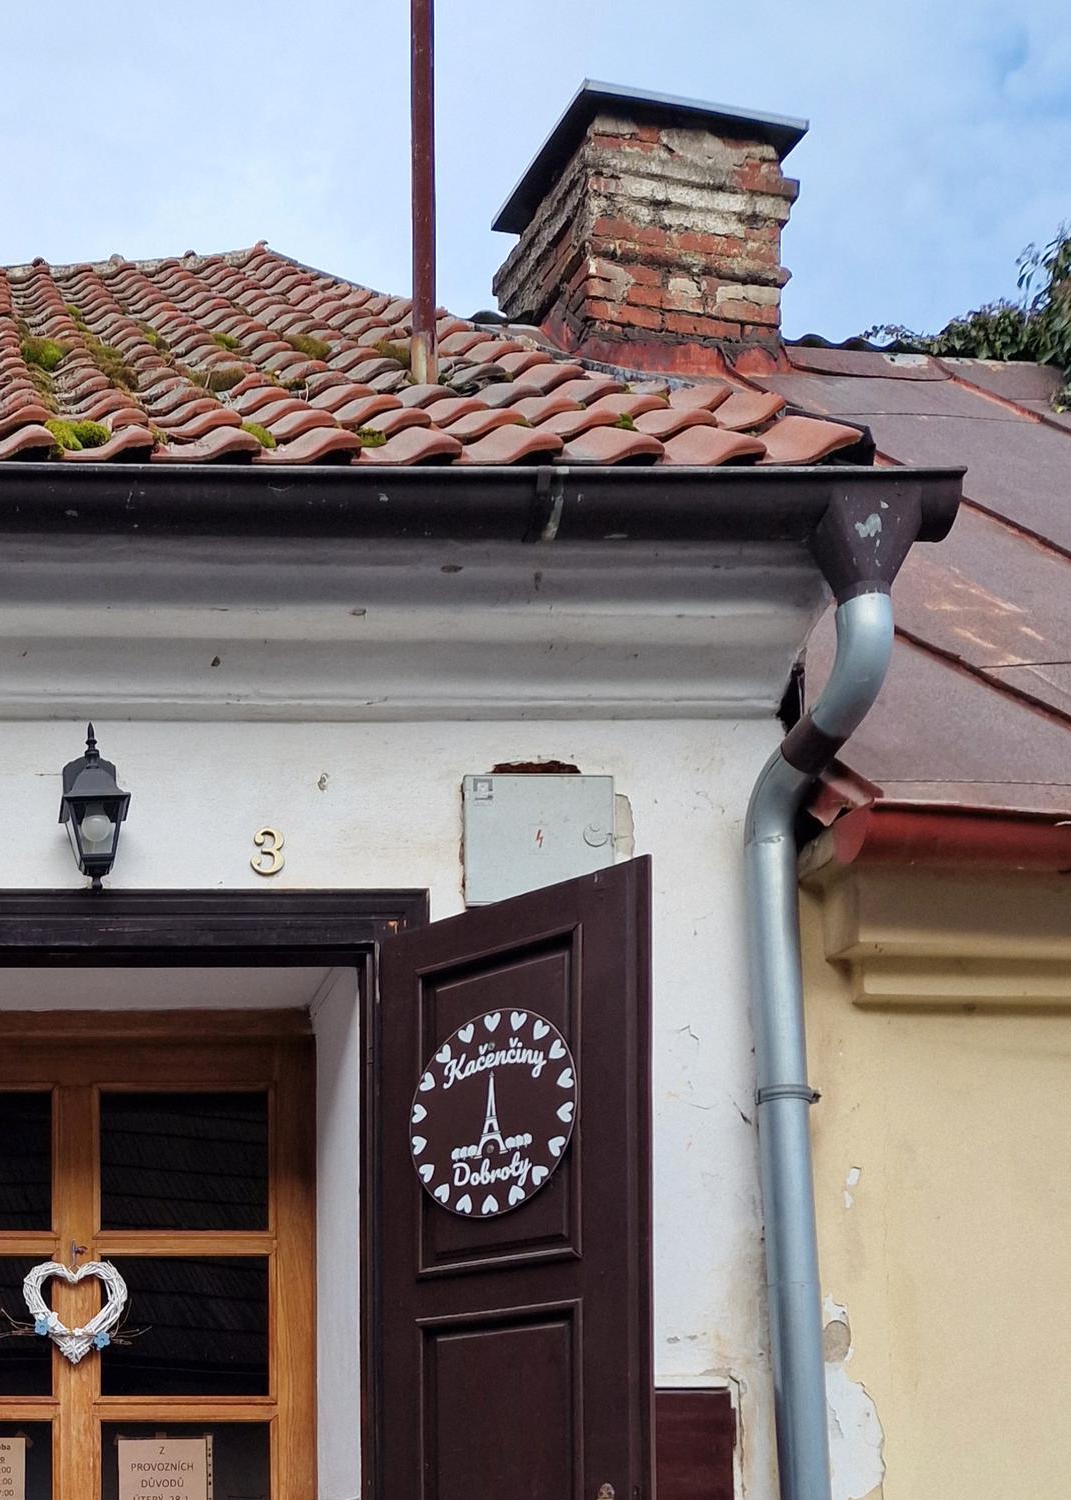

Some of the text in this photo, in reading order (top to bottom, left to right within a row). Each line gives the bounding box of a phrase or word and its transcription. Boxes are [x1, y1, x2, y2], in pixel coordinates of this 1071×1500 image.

[250, 828, 285, 876] 3
[443, 1037, 546, 1089] Kačenčiny
[453, 1151, 532, 1187] Dobroty
[159, 1446, 165, 1455] Z
[131, 1462, 194, 1472] PROVOZNÍCH
[141, 1477, 184, 1488] DŮVODŮ
